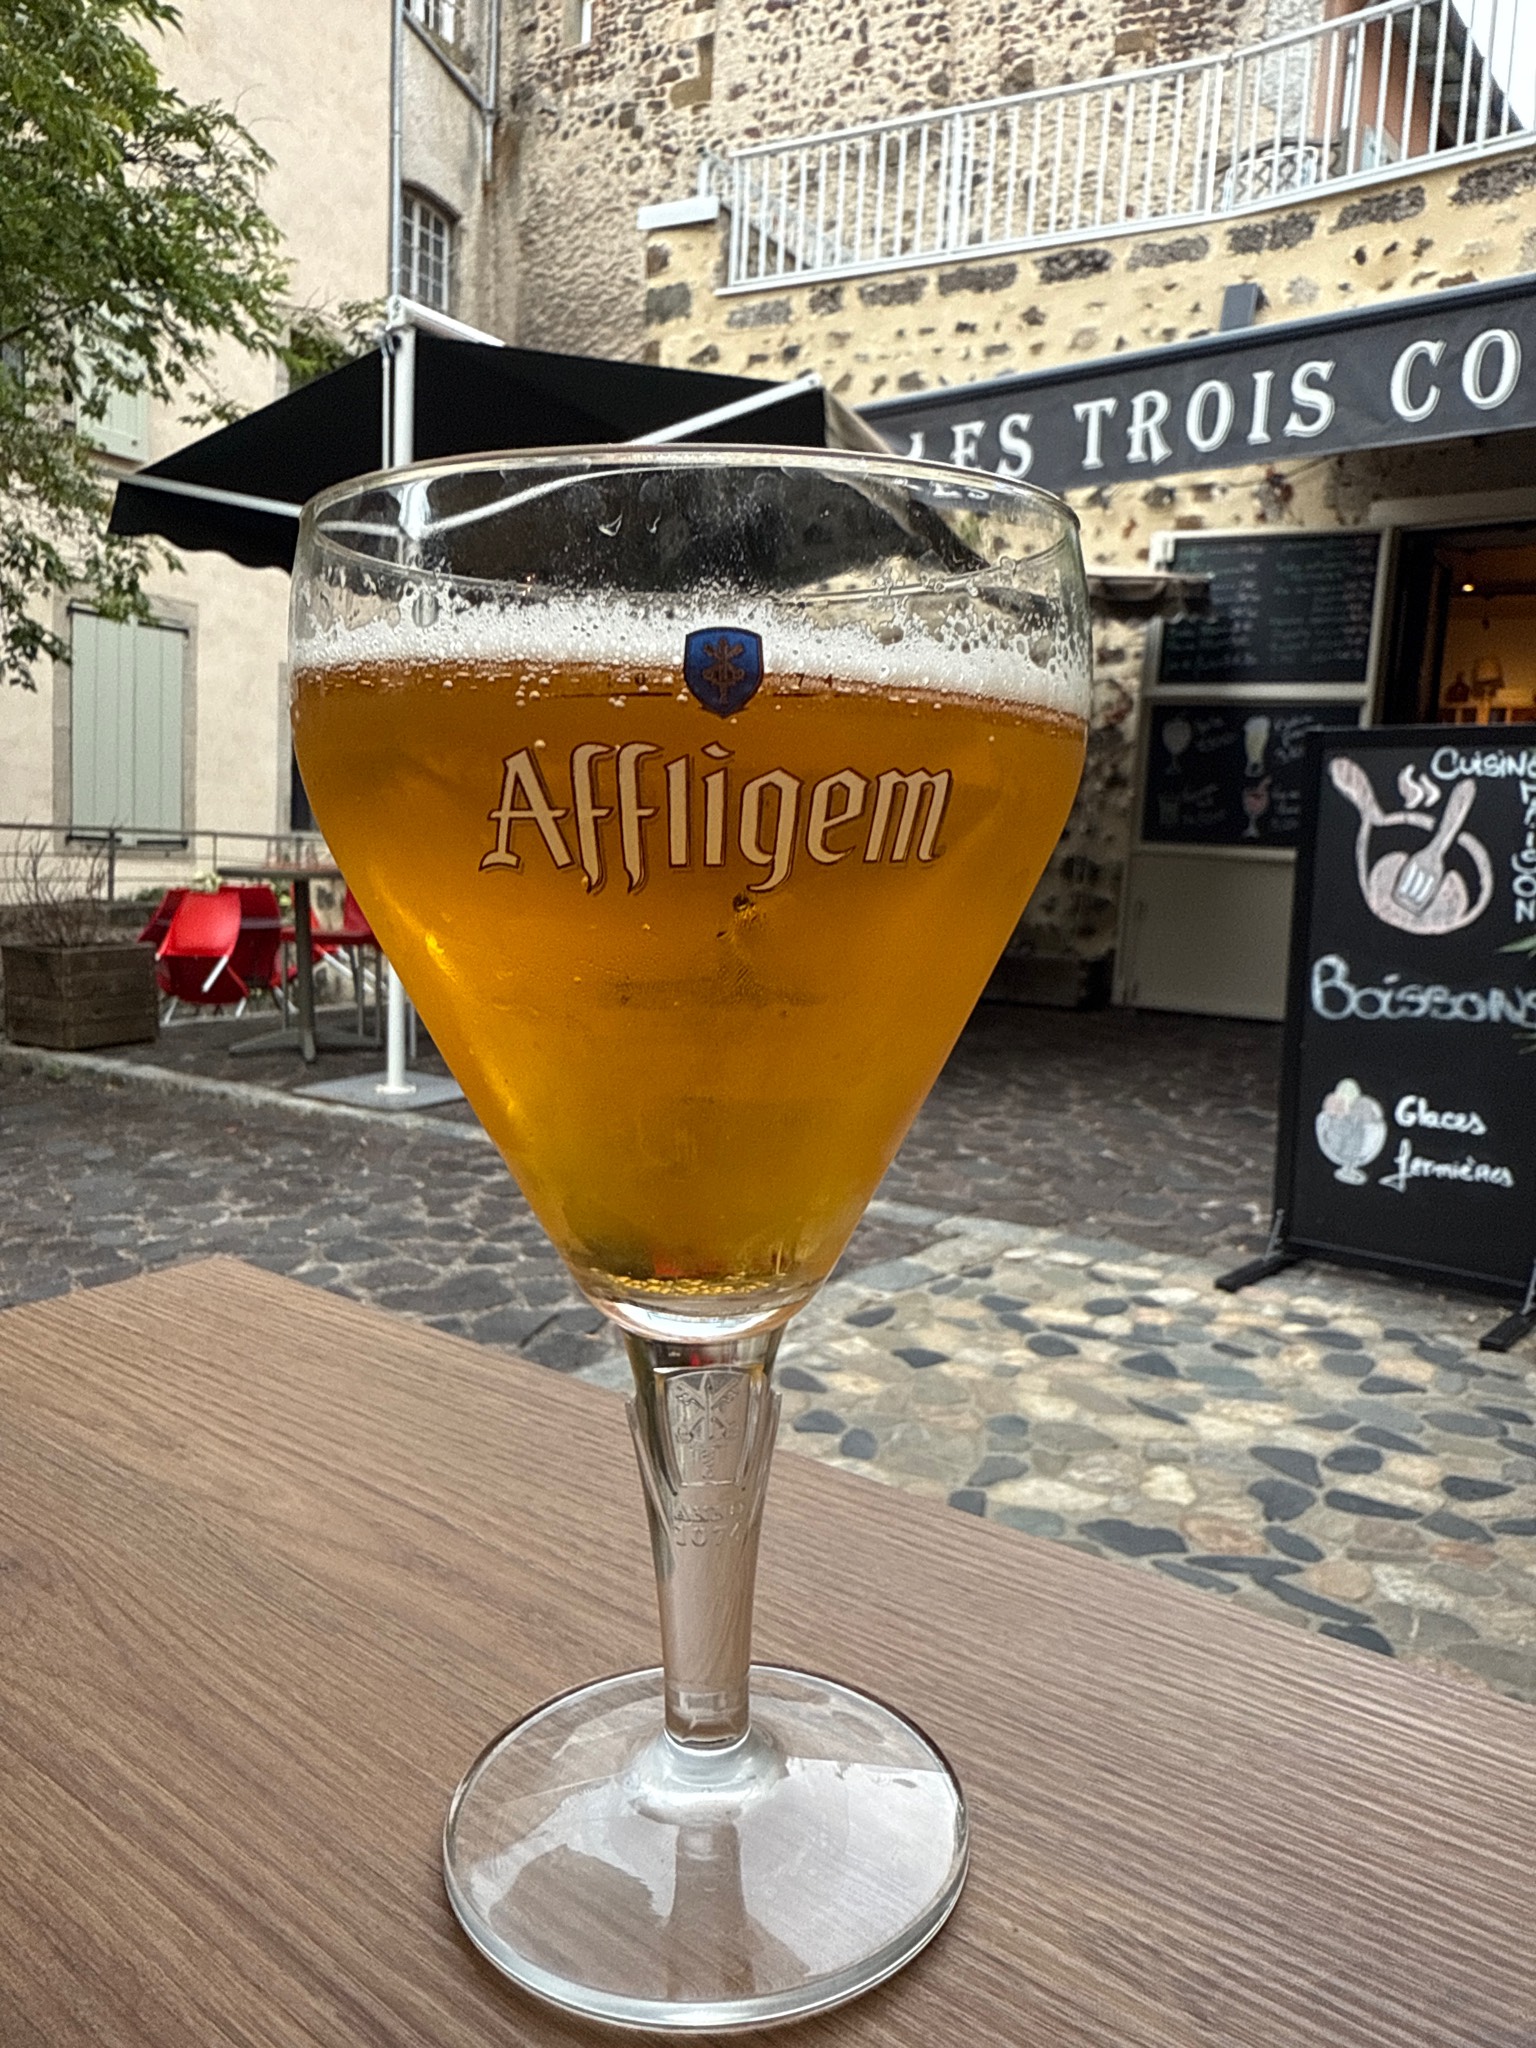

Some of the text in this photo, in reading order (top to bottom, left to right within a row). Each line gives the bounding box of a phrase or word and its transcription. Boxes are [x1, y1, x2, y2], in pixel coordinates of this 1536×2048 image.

[1073, 360, 1337, 469] TROIS
[1389, 328, 1521, 422] CO
[479, 741, 954, 894] Affligem
[1394, 1095, 1487, 1135] Glaces
